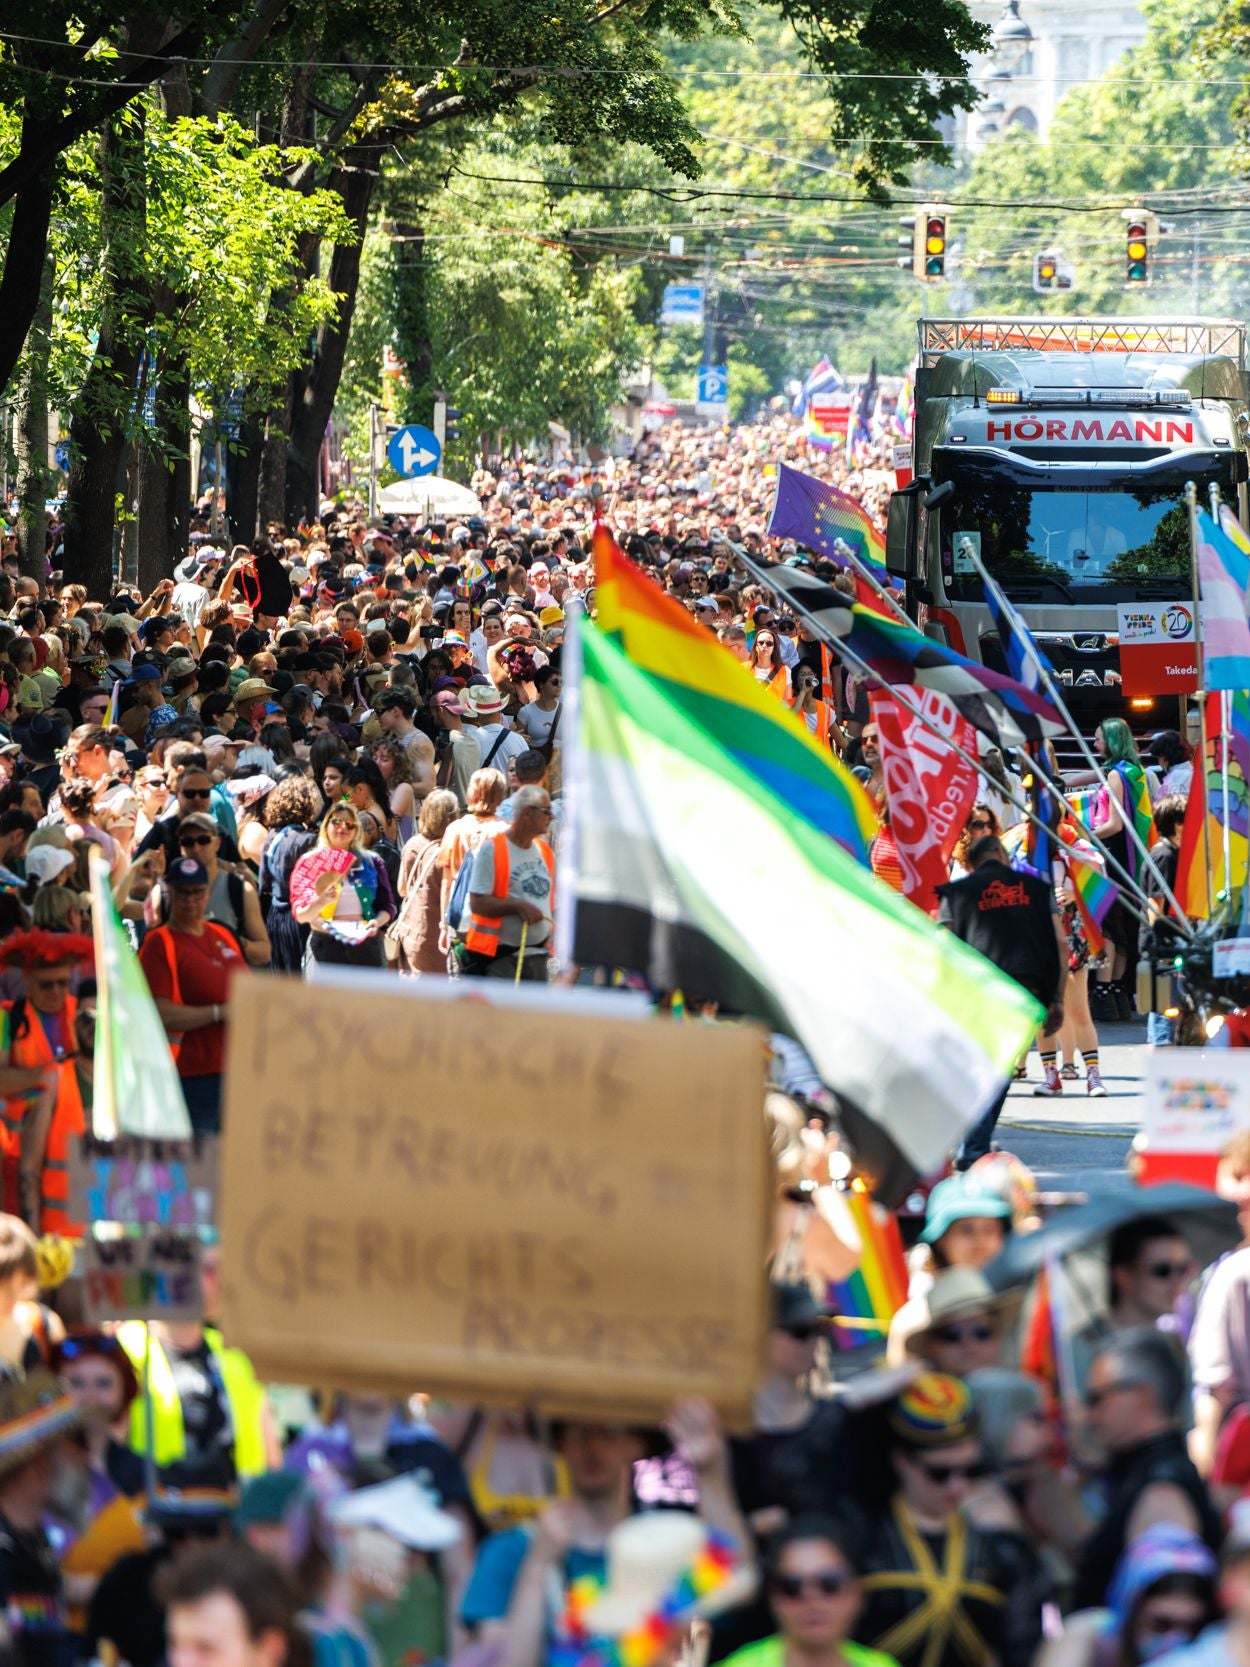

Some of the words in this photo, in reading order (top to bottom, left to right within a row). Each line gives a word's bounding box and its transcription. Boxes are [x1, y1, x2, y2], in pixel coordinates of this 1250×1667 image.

[986, 415, 1193, 443] HÖRMANN
[1123, 614, 1157, 622] VIENNA
[1126, 621, 1153, 629] PRIDE
[1164, 665, 1199, 675] Takeda
[1051, 669, 1122, 686] MAN
[242, 1202, 596, 1305] GERICHTS
